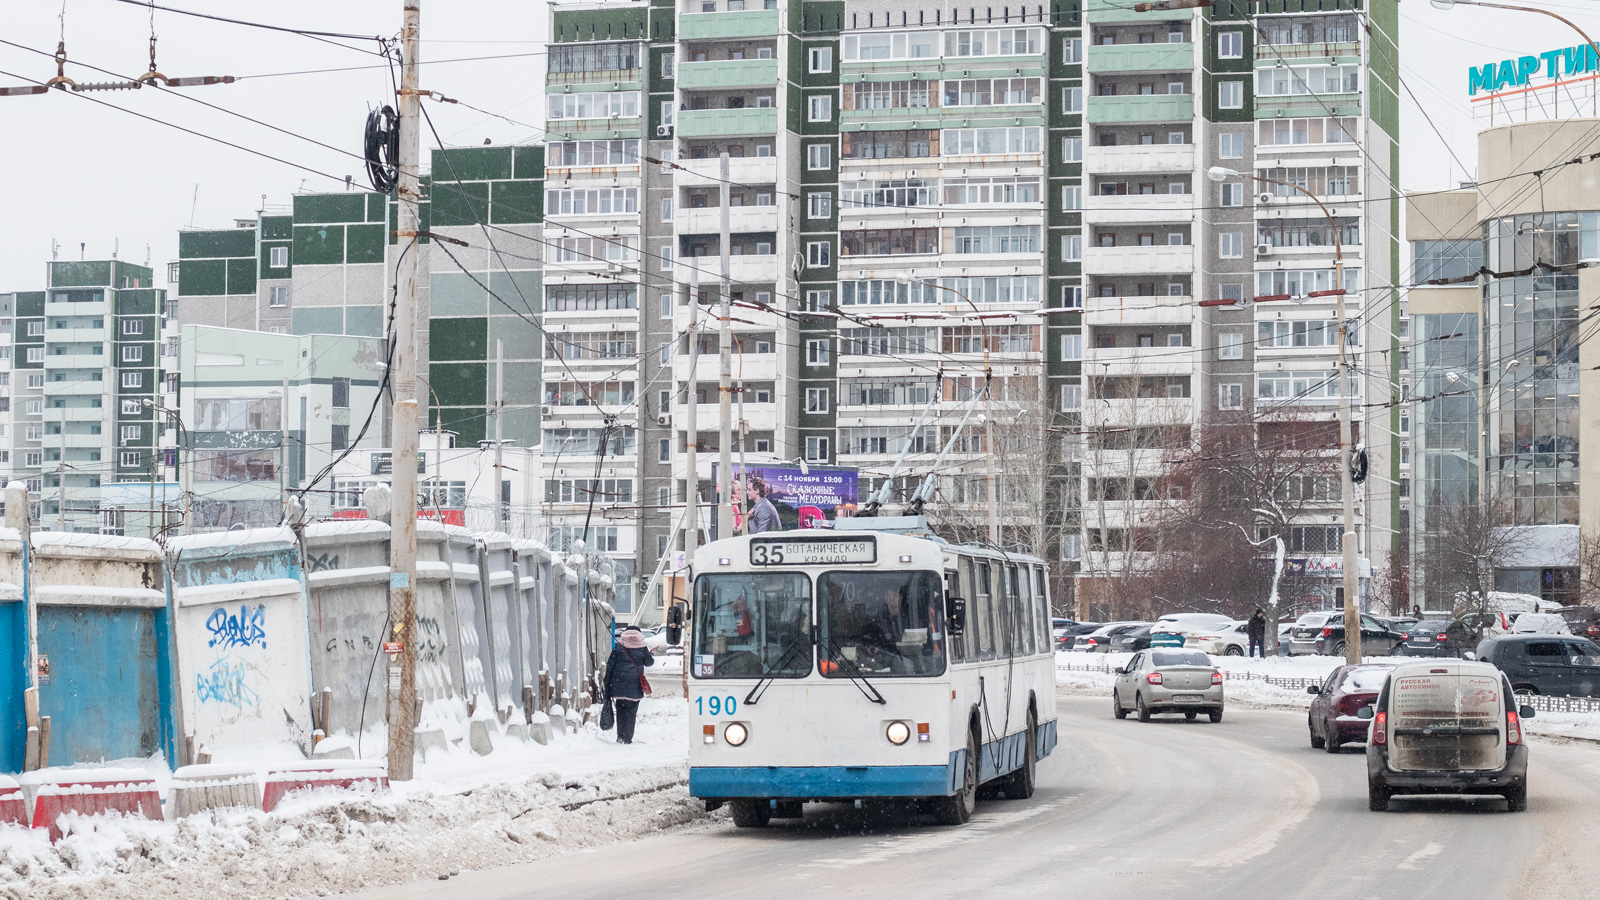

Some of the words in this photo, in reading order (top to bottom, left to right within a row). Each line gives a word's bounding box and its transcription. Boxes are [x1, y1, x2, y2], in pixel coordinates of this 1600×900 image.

[783, 474, 793, 482] 14
[823, 476, 843, 484] 19:00
[755, 545, 784, 564] 35
[786, 543, 866, 554] БОТАНИЧЕСКАЯ
[702, 666, 713, 675] 35
[695, 695, 737, 716] 190
[1432, 719, 1484, 727] ДОСТАВКА
